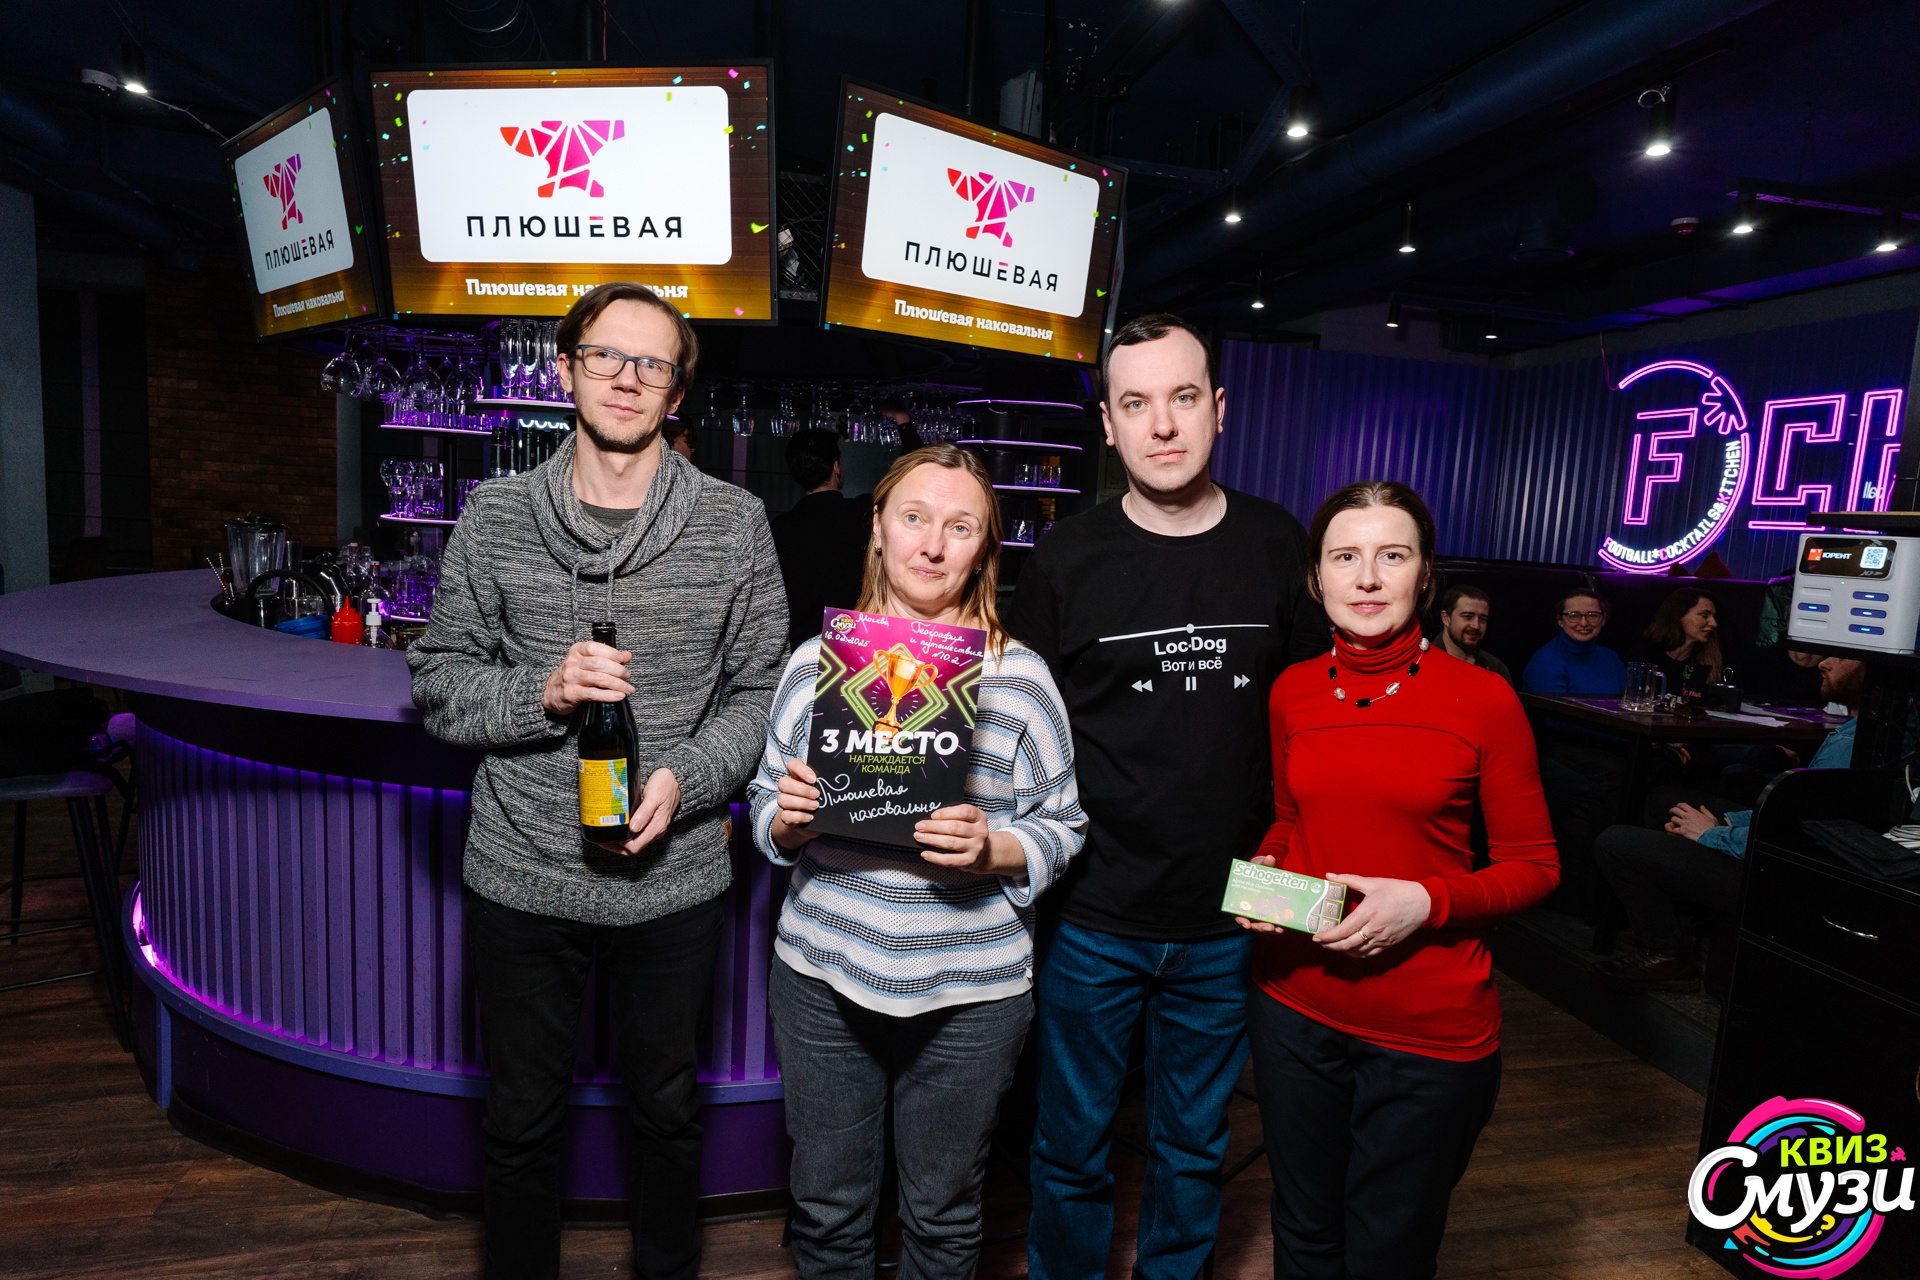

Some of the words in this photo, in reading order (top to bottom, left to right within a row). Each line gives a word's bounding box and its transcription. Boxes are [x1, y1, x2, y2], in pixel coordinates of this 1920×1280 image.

[466, 215, 683, 239] ПЛЮШЕВАЯ
[265, 229, 335, 270] ПЛЮШЕВАЯ
[904, 240, 1059, 292] ПЛЮШЕВАЯ
[466, 278, 568, 296] Плюшевая
[272, 300, 306, 318] Плюшевая
[305, 290, 345, 310] наковальня
[894, 299, 974, 328] Плюшевая
[976, 317, 1054, 341] наковальня
[855, 612, 890, 627] Москва
[910, 620, 965, 643] География
[920, 639, 984, 658] путешествия
[1161, 660, 1187, 672] Вот
[1188, 661, 1195, 670] и
[1198, 656, 1223, 670] всё
[820, 728, 840, 754] 3
[844, 729, 960, 756] МЕСТО
[849, 754, 926, 765] НАГРАЖДАЕТСЯ
[861, 764, 911, 775] КОМАНДА
[816, 773, 909, 809] Плюшевая
[849, 800, 942, 824] наковальня
[1232, 861, 1308, 891] Schogetten
